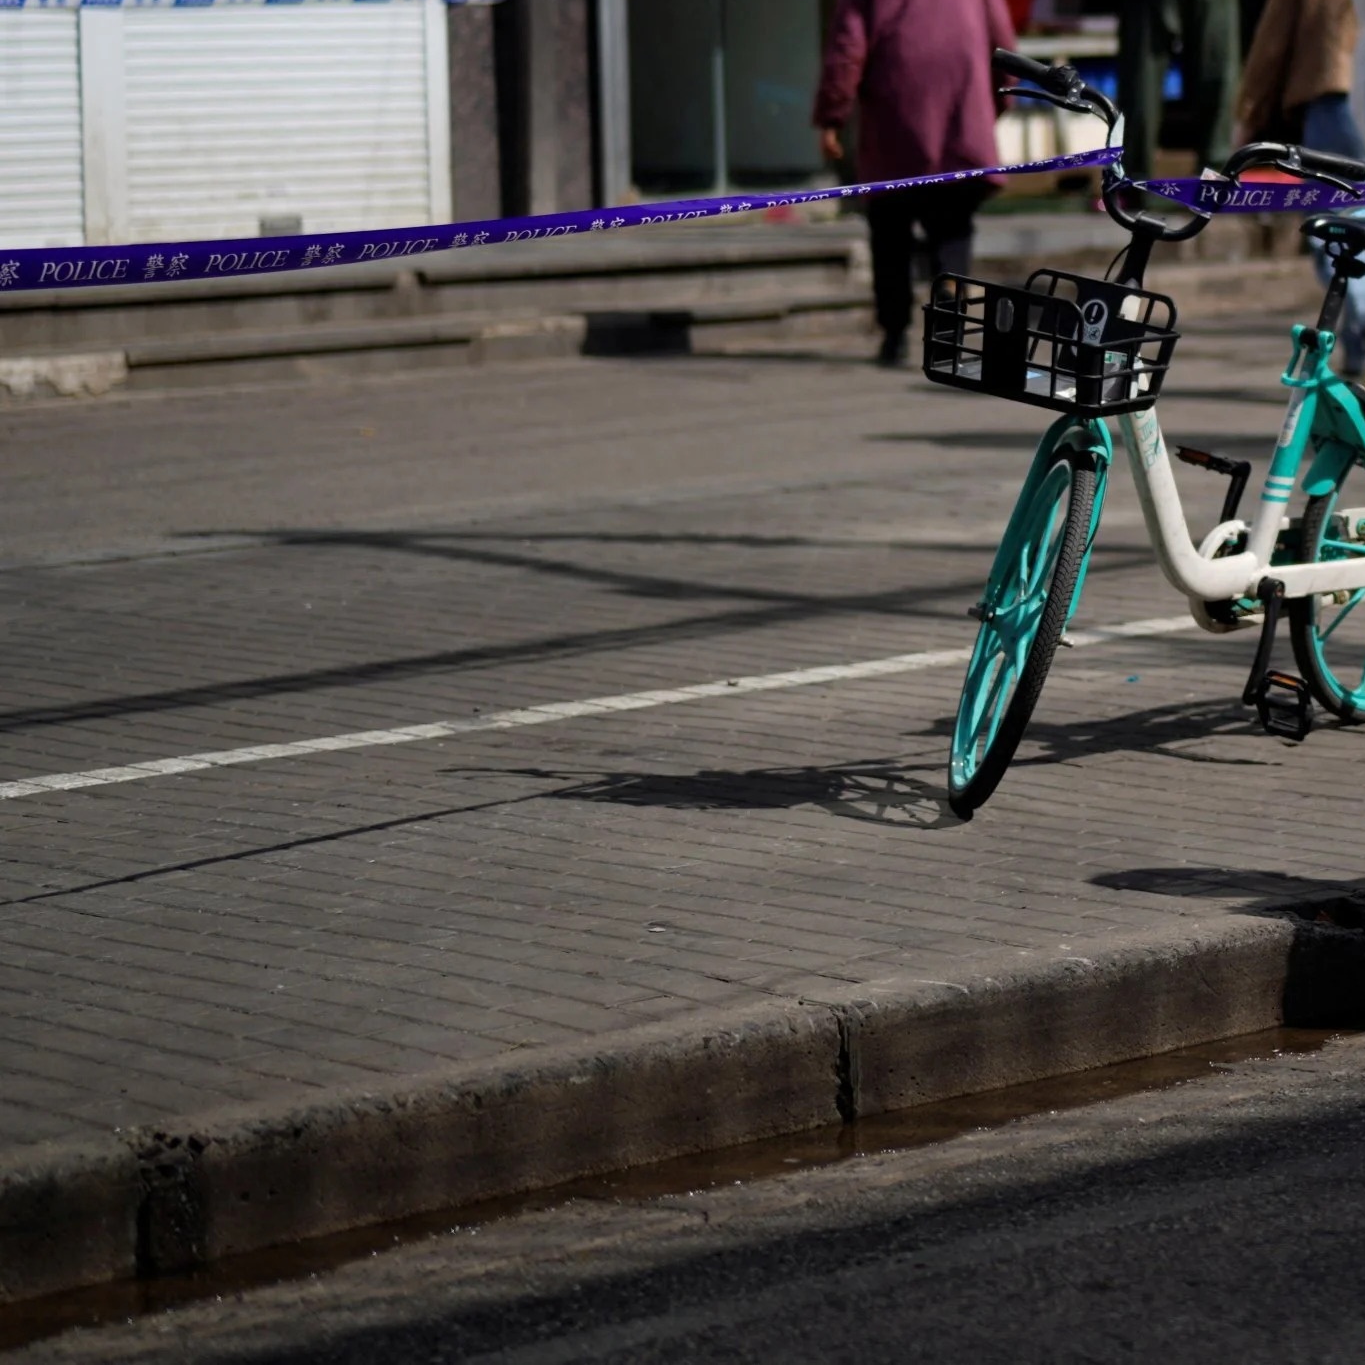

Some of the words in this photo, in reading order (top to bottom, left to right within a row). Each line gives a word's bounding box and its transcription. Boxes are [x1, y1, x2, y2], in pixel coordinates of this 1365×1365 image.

[1200, 184, 1274, 207] POLICE
[1283, 188, 1320, 207] 警察
[38, 258, 130, 283] POLICE
[142, 252, 190, 280] 警察
[203, 249, 290, 273] POLICE
[301, 242, 345, 266] 警察
[357, 238, 438, 260] POLICE
